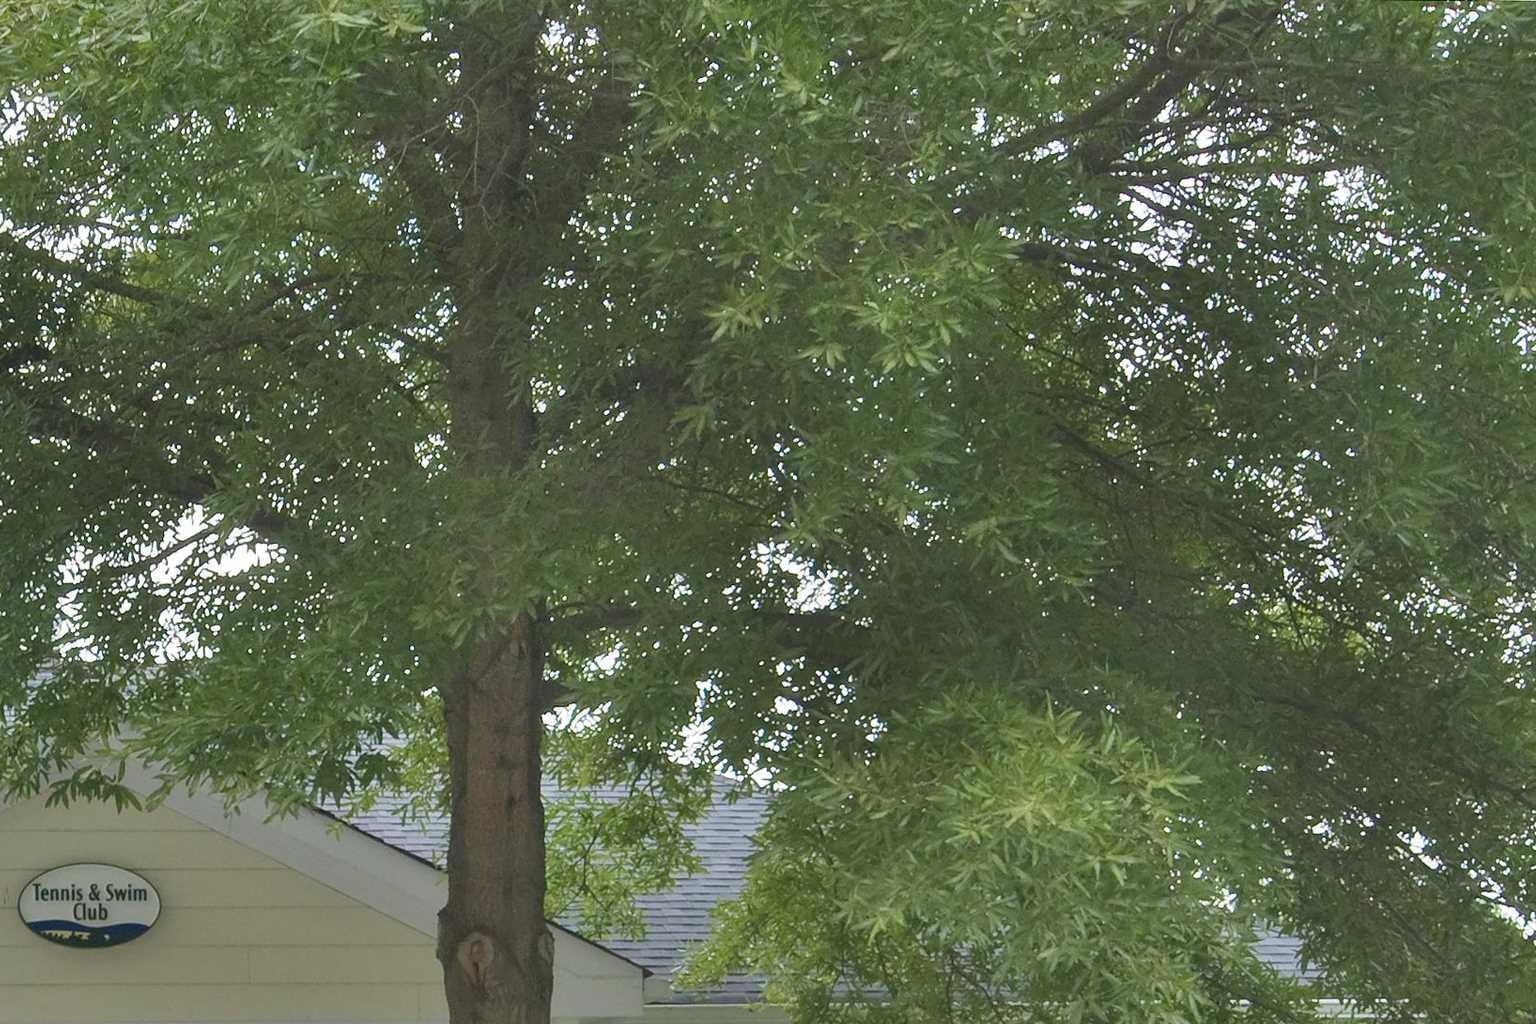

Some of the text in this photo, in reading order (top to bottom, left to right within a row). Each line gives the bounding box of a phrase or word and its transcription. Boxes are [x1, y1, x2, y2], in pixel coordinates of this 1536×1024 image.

[32, 883, 148, 901] Tennis & Swim
[73, 902, 108, 920] Club
